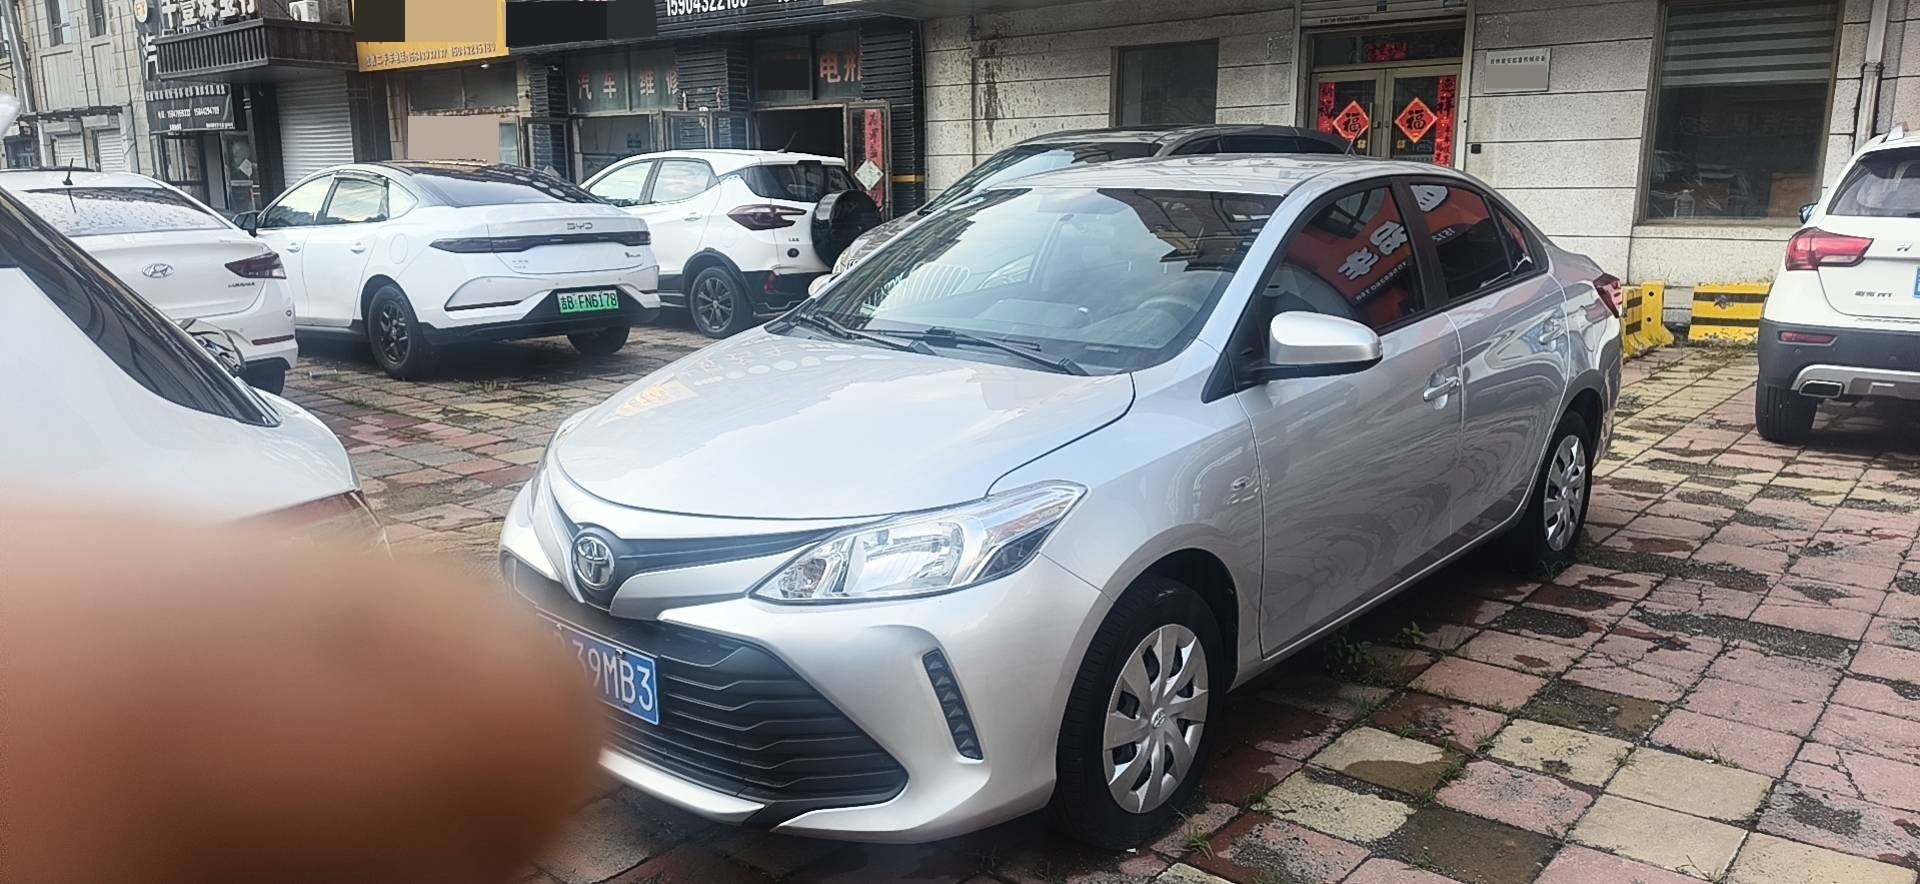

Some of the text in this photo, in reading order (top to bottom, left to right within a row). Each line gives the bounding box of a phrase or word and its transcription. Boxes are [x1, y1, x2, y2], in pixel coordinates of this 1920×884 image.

[1343, 111, 1362, 132] 福
[1406, 109, 1426, 131] 福
[567, 222, 593, 230] BYD
[579, 292, 617, 310] FN6178
